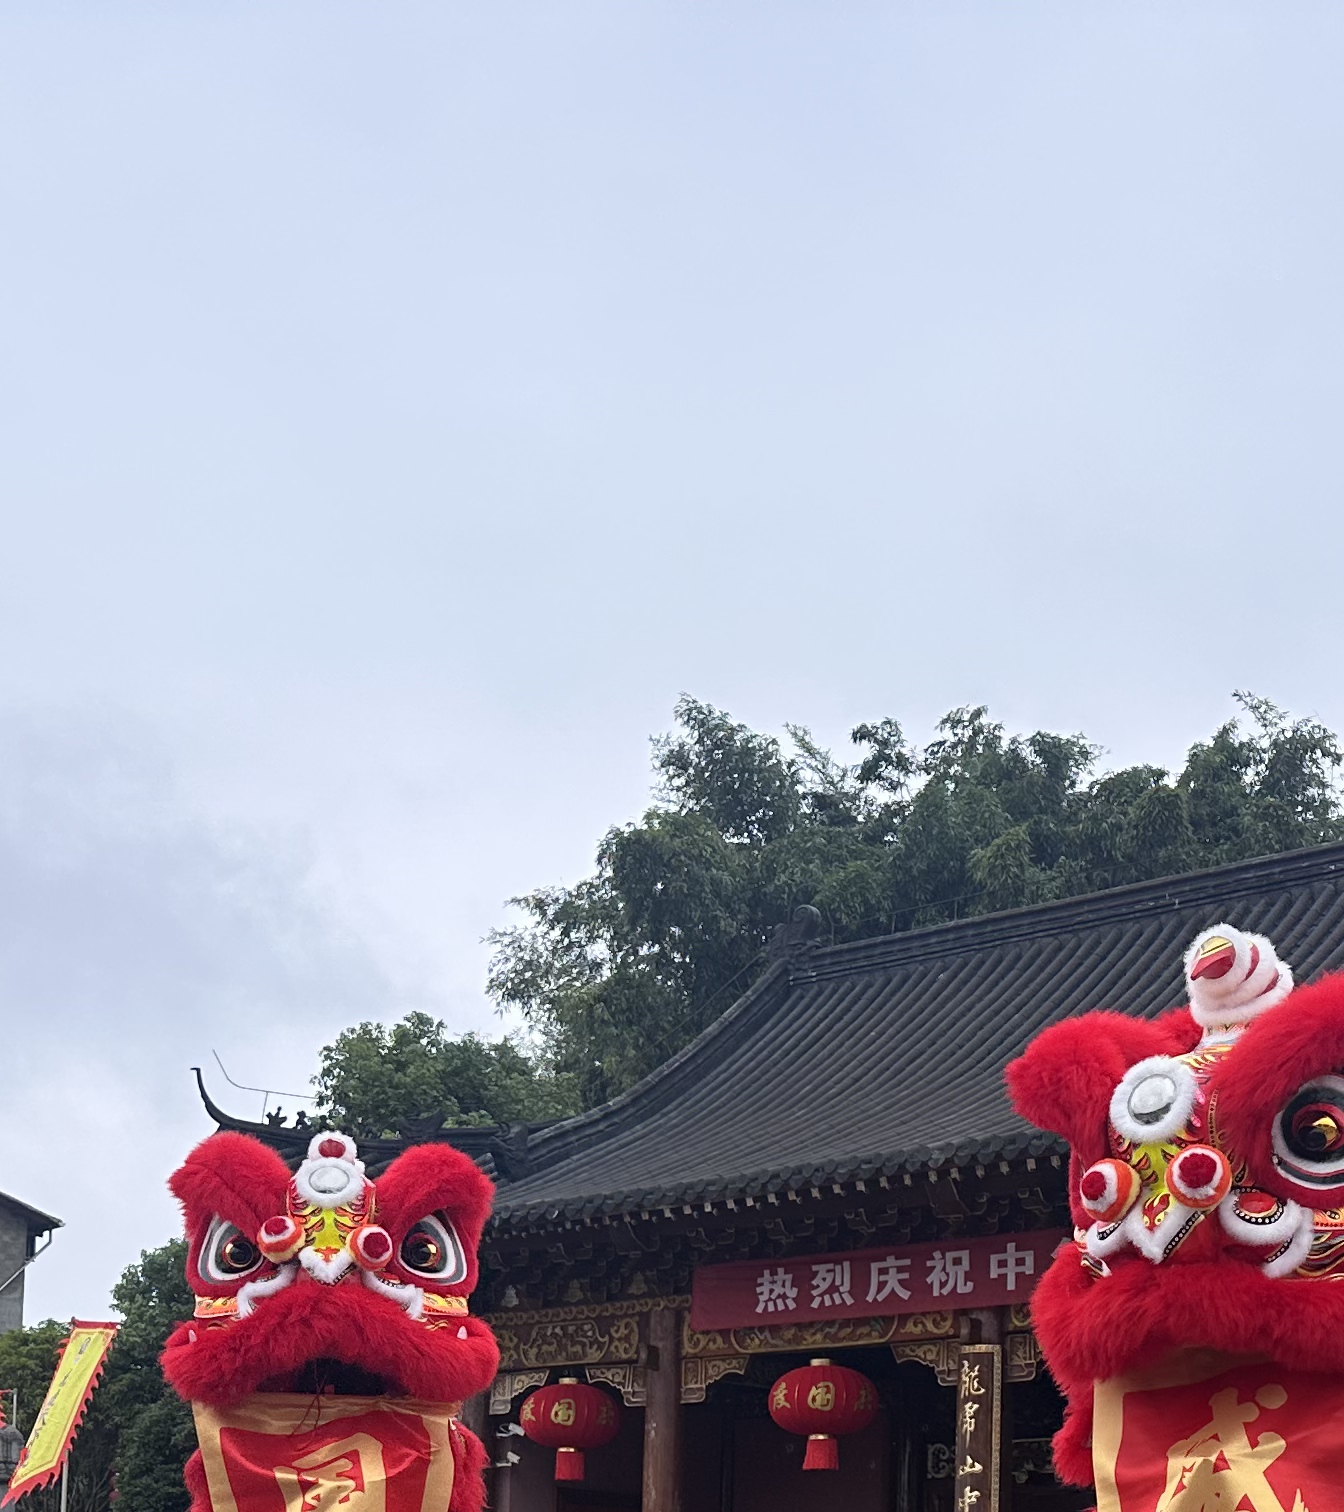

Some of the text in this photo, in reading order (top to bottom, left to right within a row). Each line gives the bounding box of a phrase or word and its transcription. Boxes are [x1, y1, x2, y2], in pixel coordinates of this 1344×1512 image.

[754, 1238, 1071, 1315] 热烈庆祝中
